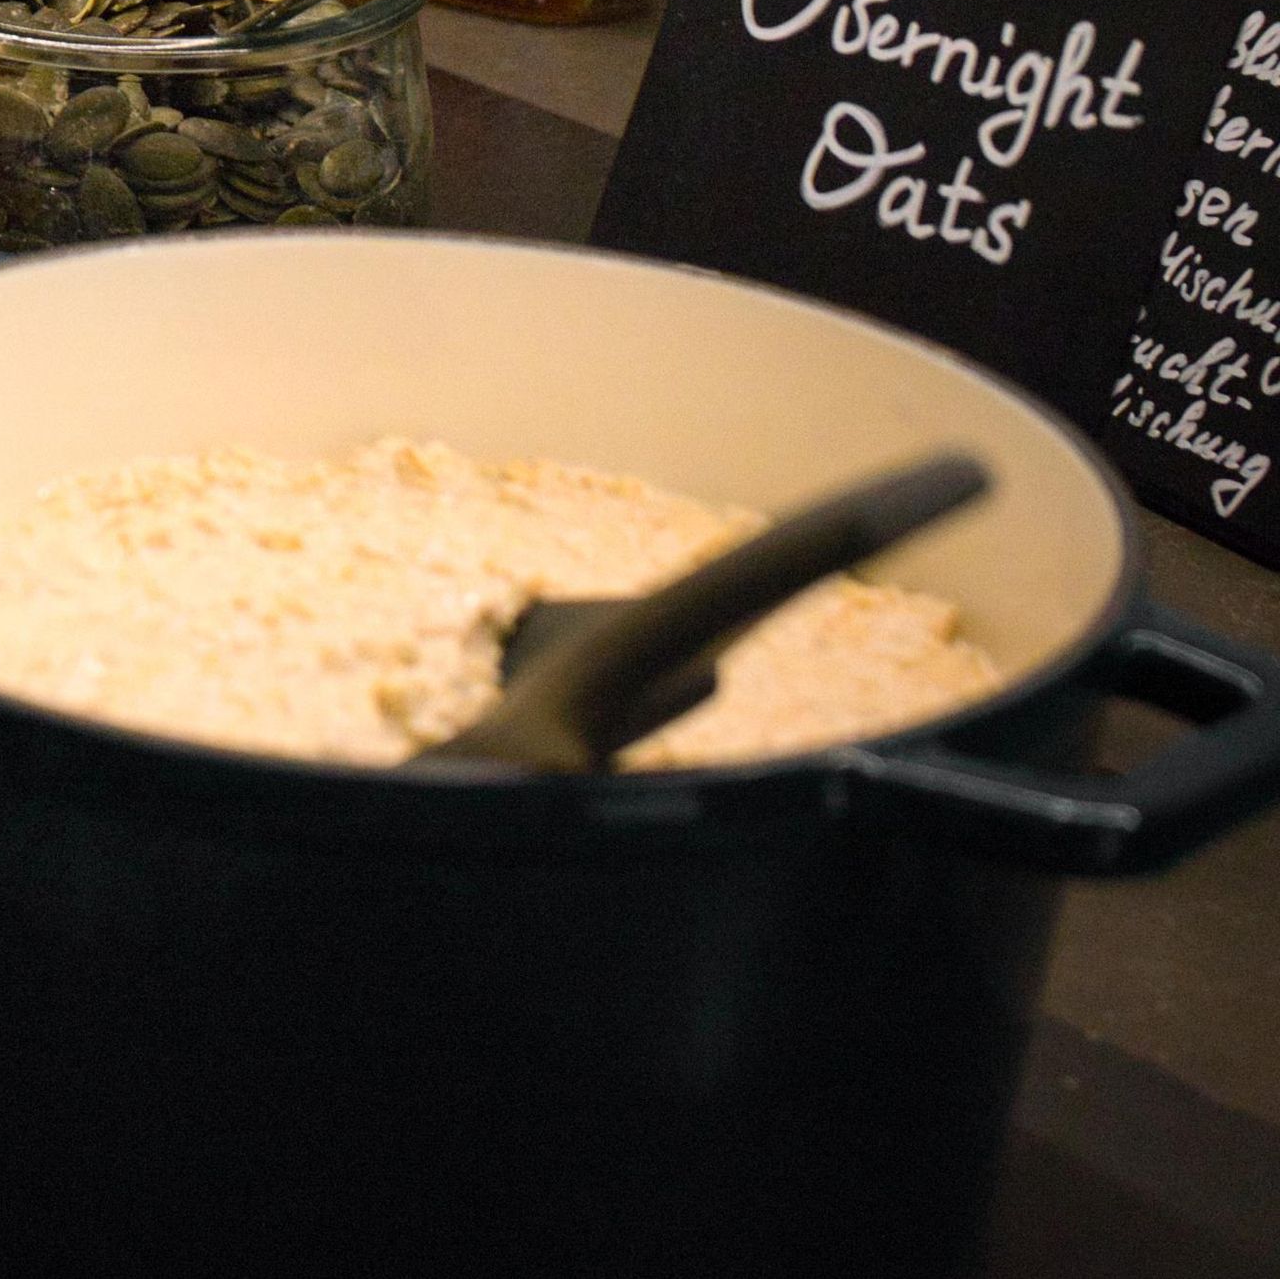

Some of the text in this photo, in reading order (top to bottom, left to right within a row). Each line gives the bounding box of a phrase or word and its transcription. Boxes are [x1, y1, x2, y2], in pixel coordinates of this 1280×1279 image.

[800, 101, 1032, 266] Oats
[1175, 179, 1259, 247] sen
[1160, 230, 1280, 346] Mischu
[1130, 333, 1252, 411] ucht-
